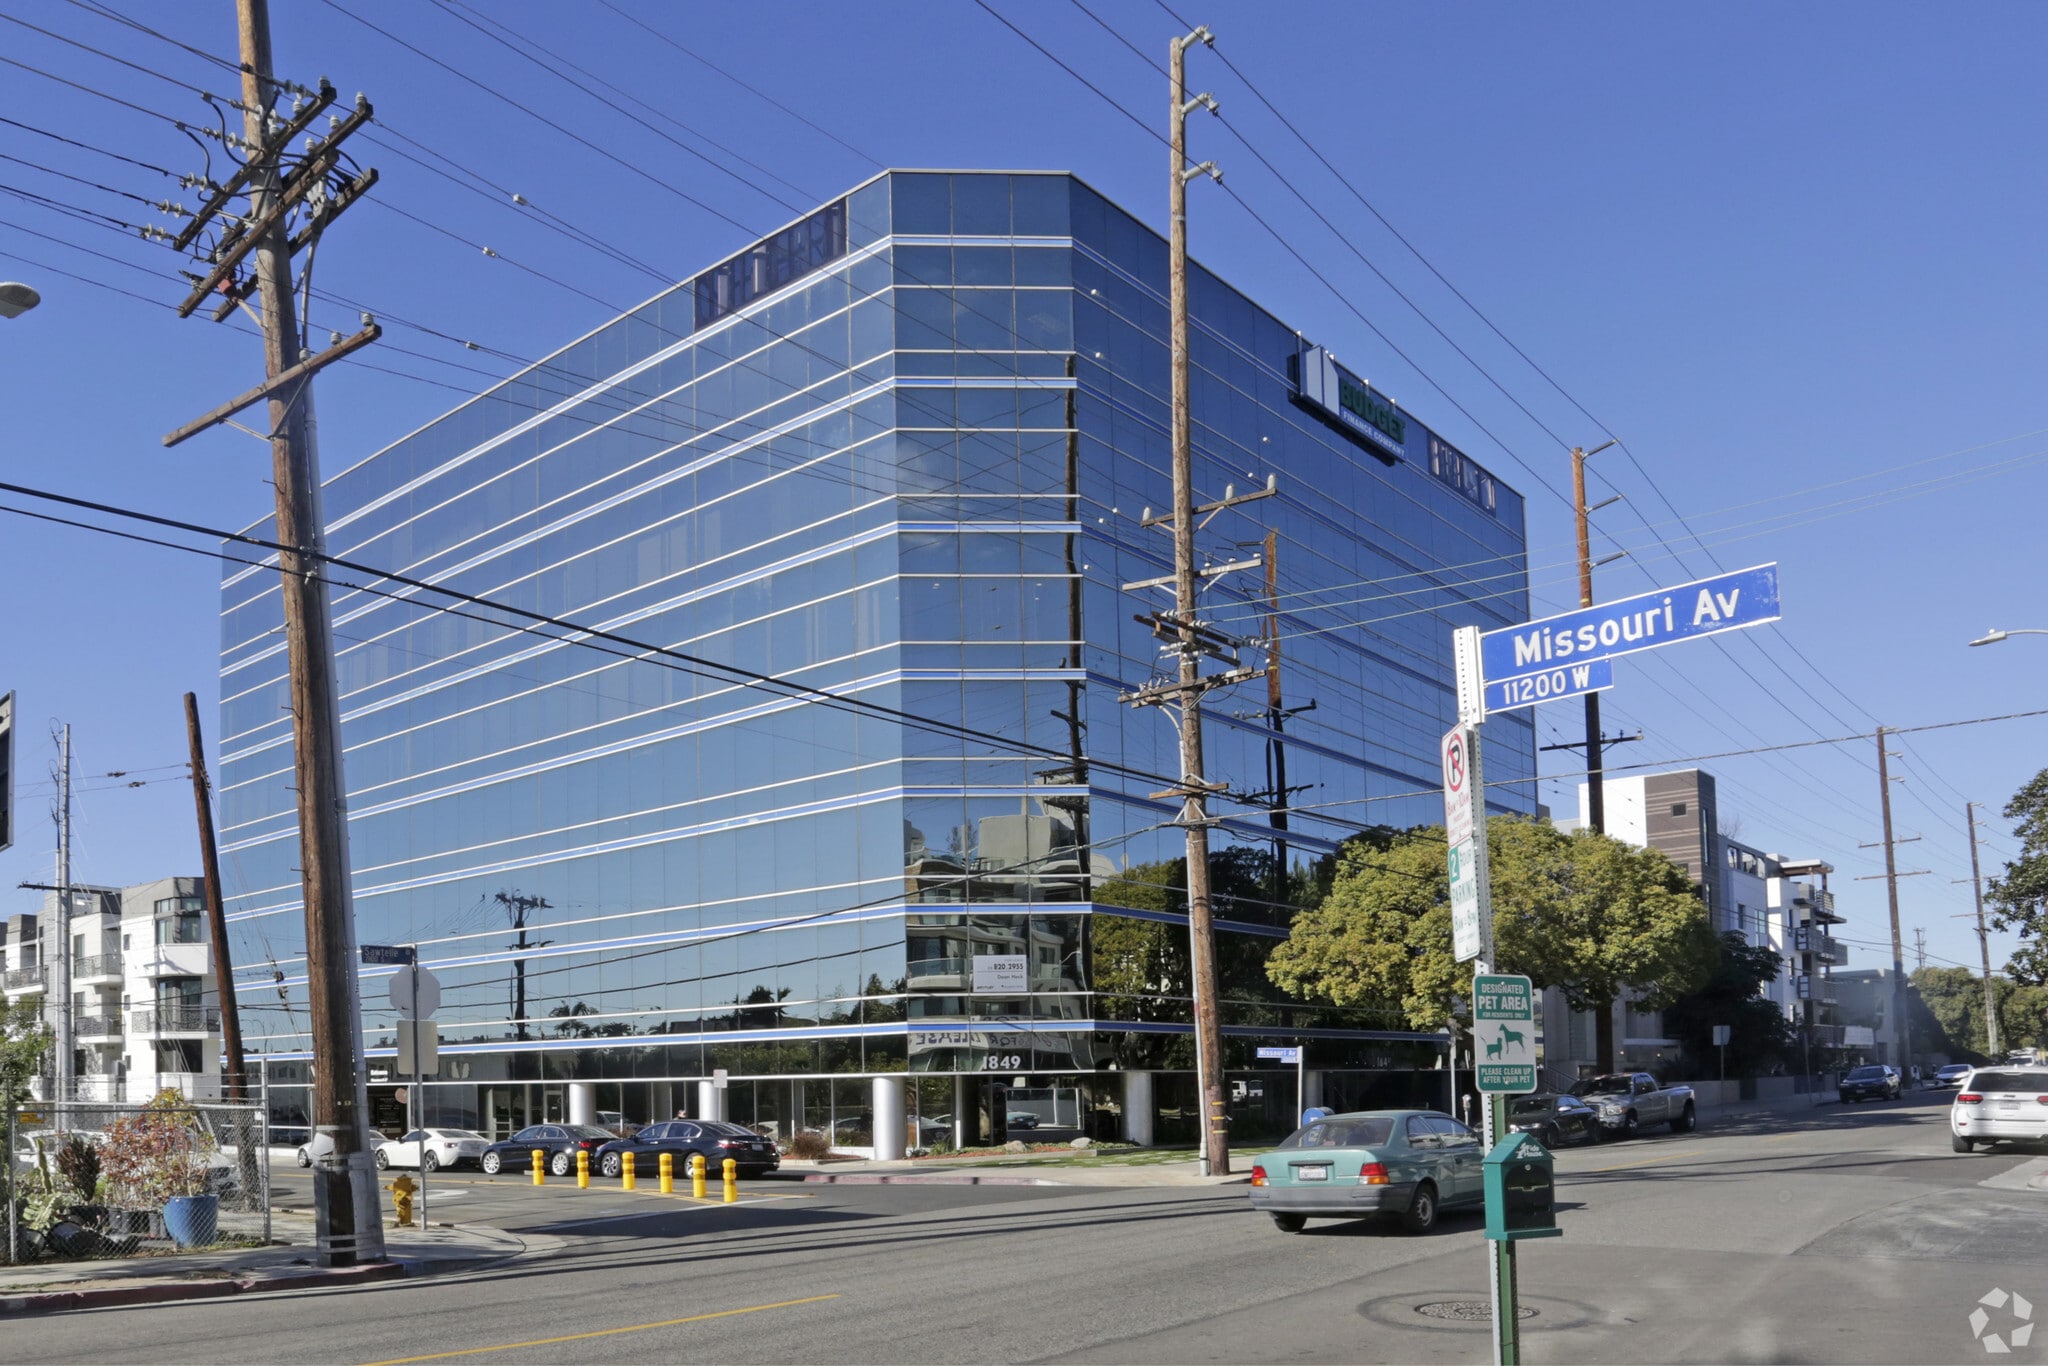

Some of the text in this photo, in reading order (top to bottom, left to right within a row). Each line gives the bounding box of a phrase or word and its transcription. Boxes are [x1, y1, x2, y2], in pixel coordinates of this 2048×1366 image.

[1341, 380, 1406, 444] BUDGET
[1343, 410, 1405, 457] FINANCE COMPANY
[1513, 588, 1740, 667] Missouri Av
[1503, 665, 1591, 704] 11200 W
[1450, 854, 1457, 877] 2
[1452, 878, 1475, 907] PARKING
[365, 947, 399, 957] Sawtelle
[1481, 984, 1524, 994] DESIGNATED
[1478, 996, 1528, 1010] PET AREA
[982, 1056, 1021, 1070] 1849
